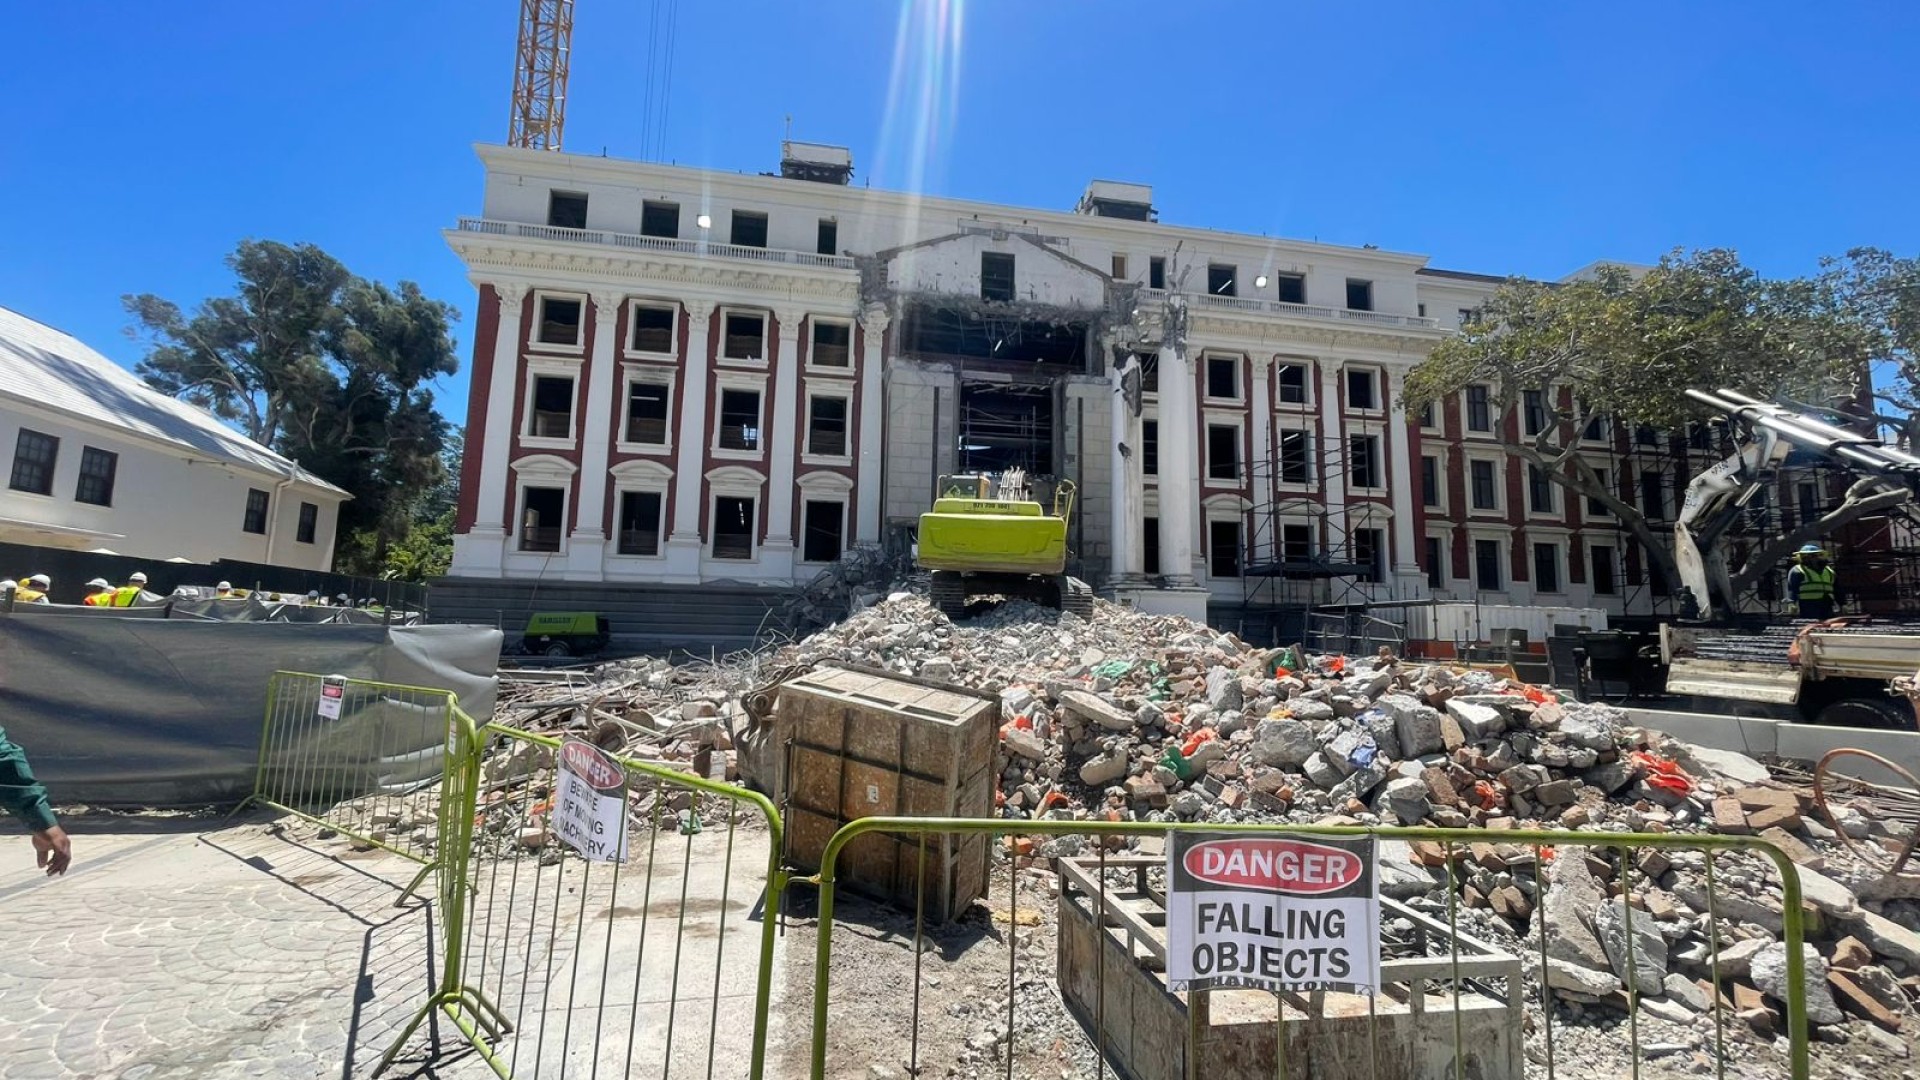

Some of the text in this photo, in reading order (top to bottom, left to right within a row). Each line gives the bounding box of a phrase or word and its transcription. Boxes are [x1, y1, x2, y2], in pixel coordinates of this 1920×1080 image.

[568, 746, 611, 785] DANGER
[559, 815, 606, 856] ACHERY
[563, 798, 604, 835] OF MONG
[1202, 847, 1347, 884] DANGER
[1198, 902, 1345, 940] FALLING
[1192, 941, 1351, 979] OBJECTS
